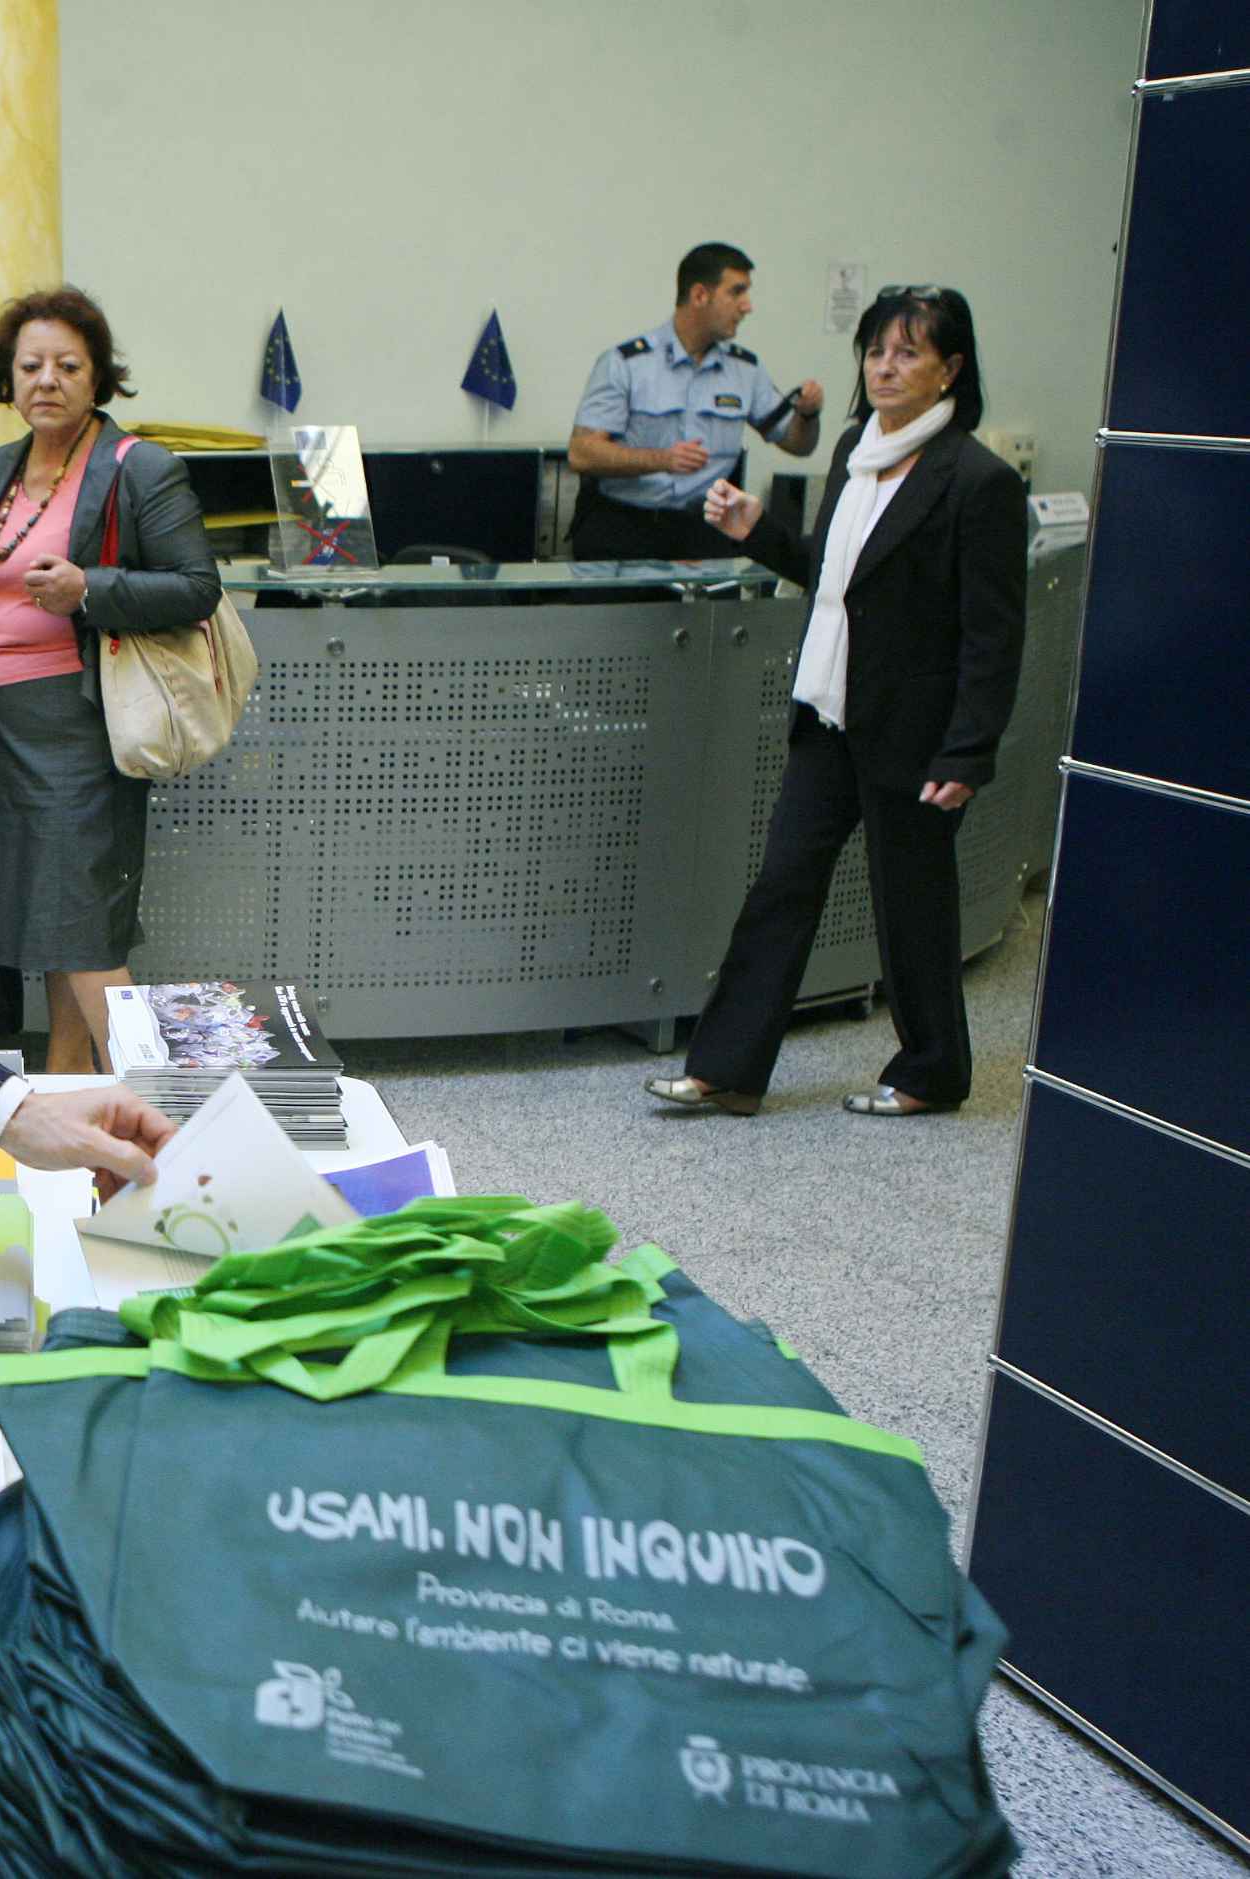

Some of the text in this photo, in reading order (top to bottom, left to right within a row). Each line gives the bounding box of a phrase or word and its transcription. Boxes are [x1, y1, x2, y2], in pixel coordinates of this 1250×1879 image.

[453, 1499, 564, 1574] NON
[581, 1514, 827, 1598] INQUINO
[416, 1570, 549, 1616] Provincia
[554, 1594, 583, 1620] di
[296, 1597, 400, 1640] Aiutare
[558, 1633, 588, 1661] ci
[594, 1638, 682, 1675] viene
[739, 1752, 901, 1798] PROVINCIA
[744, 1778, 872, 1826] DI ROMA
